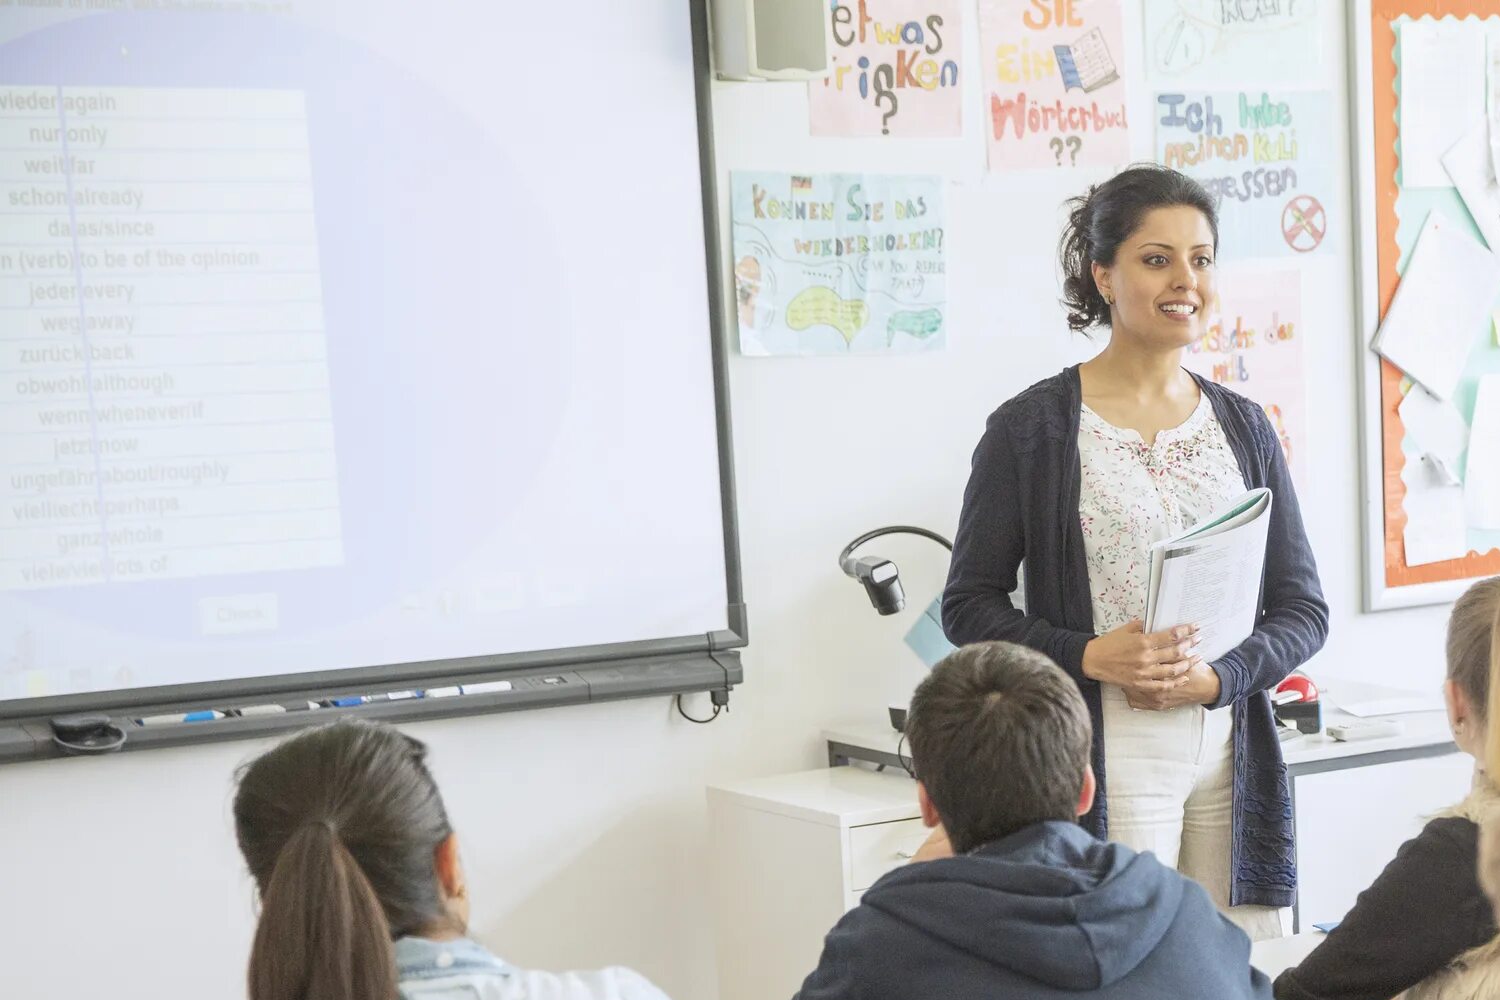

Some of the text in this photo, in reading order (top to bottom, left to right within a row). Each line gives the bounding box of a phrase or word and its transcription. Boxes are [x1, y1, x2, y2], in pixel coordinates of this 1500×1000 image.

[63, 92, 117, 116] again
[1157, 94, 1223, 135] Ich
[29, 124, 108, 150] nur only
[24, 155, 96, 175] weit far
[9, 186, 144, 212] schon already
[19, 249, 76, 275] (verb)
[80, 250, 98, 269] to
[104, 249, 127, 268] be
[133, 249, 153, 268] of
[155, 248, 187, 267] the
[191, 249, 260, 271] opinion
[28, 281, 136, 306] jeder every
[41, 314, 136, 335] weg away
[89, 342, 135, 361] back
[93, 372, 175, 397] although
[38, 408, 90, 425] wenn
[99, 437, 139, 454] now
